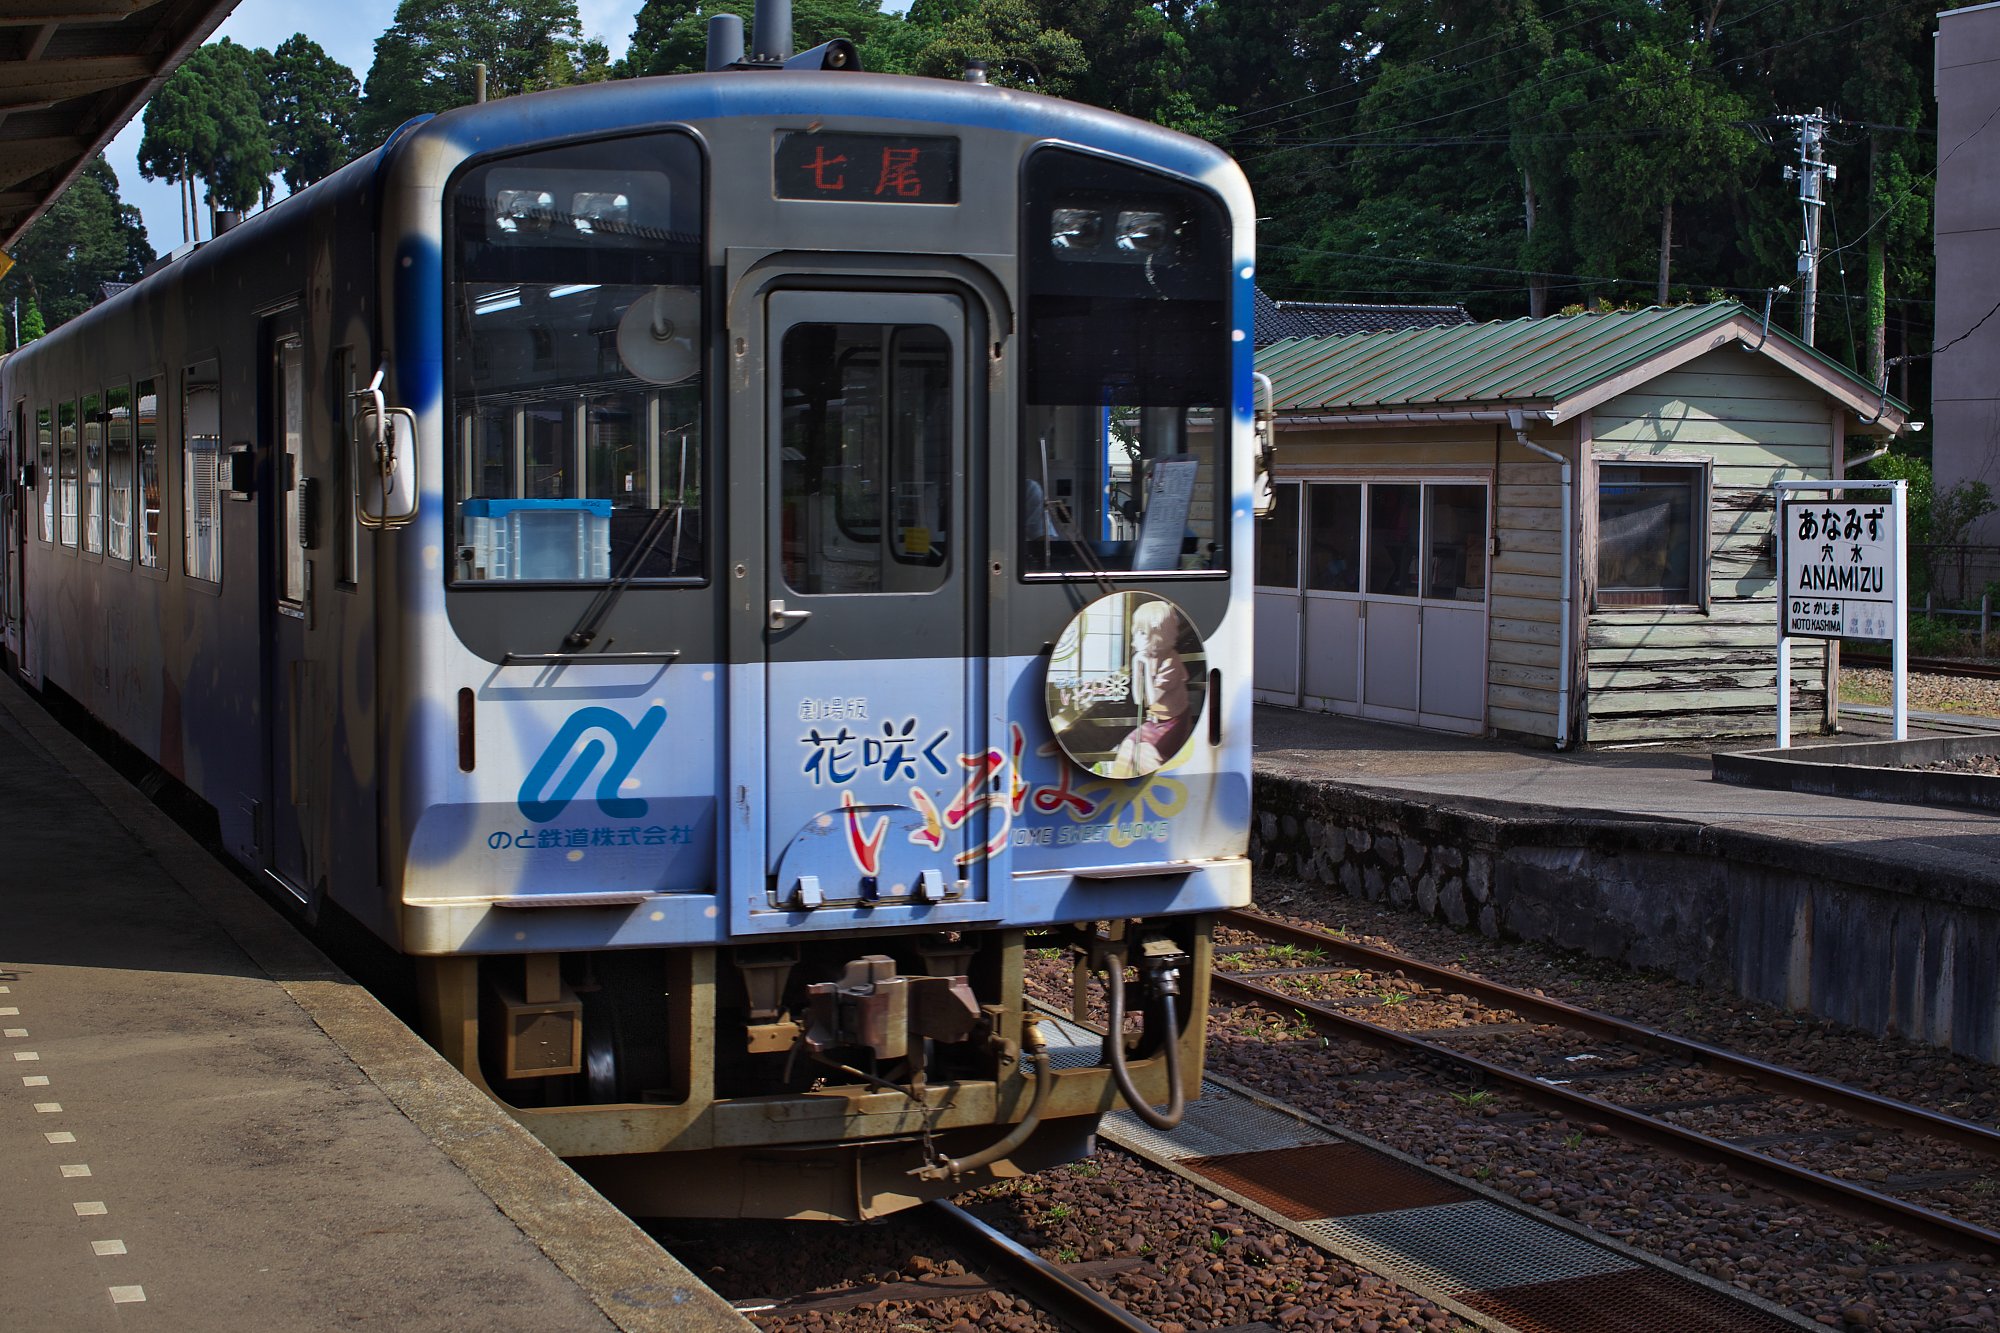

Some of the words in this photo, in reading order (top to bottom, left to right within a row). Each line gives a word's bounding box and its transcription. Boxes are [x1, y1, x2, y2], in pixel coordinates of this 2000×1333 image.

[801, 146, 921, 196] 七尾
[1799, 507, 1884, 541] あなみず
[1821, 543, 1863, 563] 穴水
[1800, 565, 1883, 593] ANAMIZU
[1792, 601, 1839, 615] のとかしま
[800, 697, 868, 720] 劇場版
[800, 717, 950, 786] 花咲く
[488, 824, 694, 849] のと鉄道株式会社
[1057, 823, 1115, 844] SWEET
[1119, 821, 1169, 841] HOME
